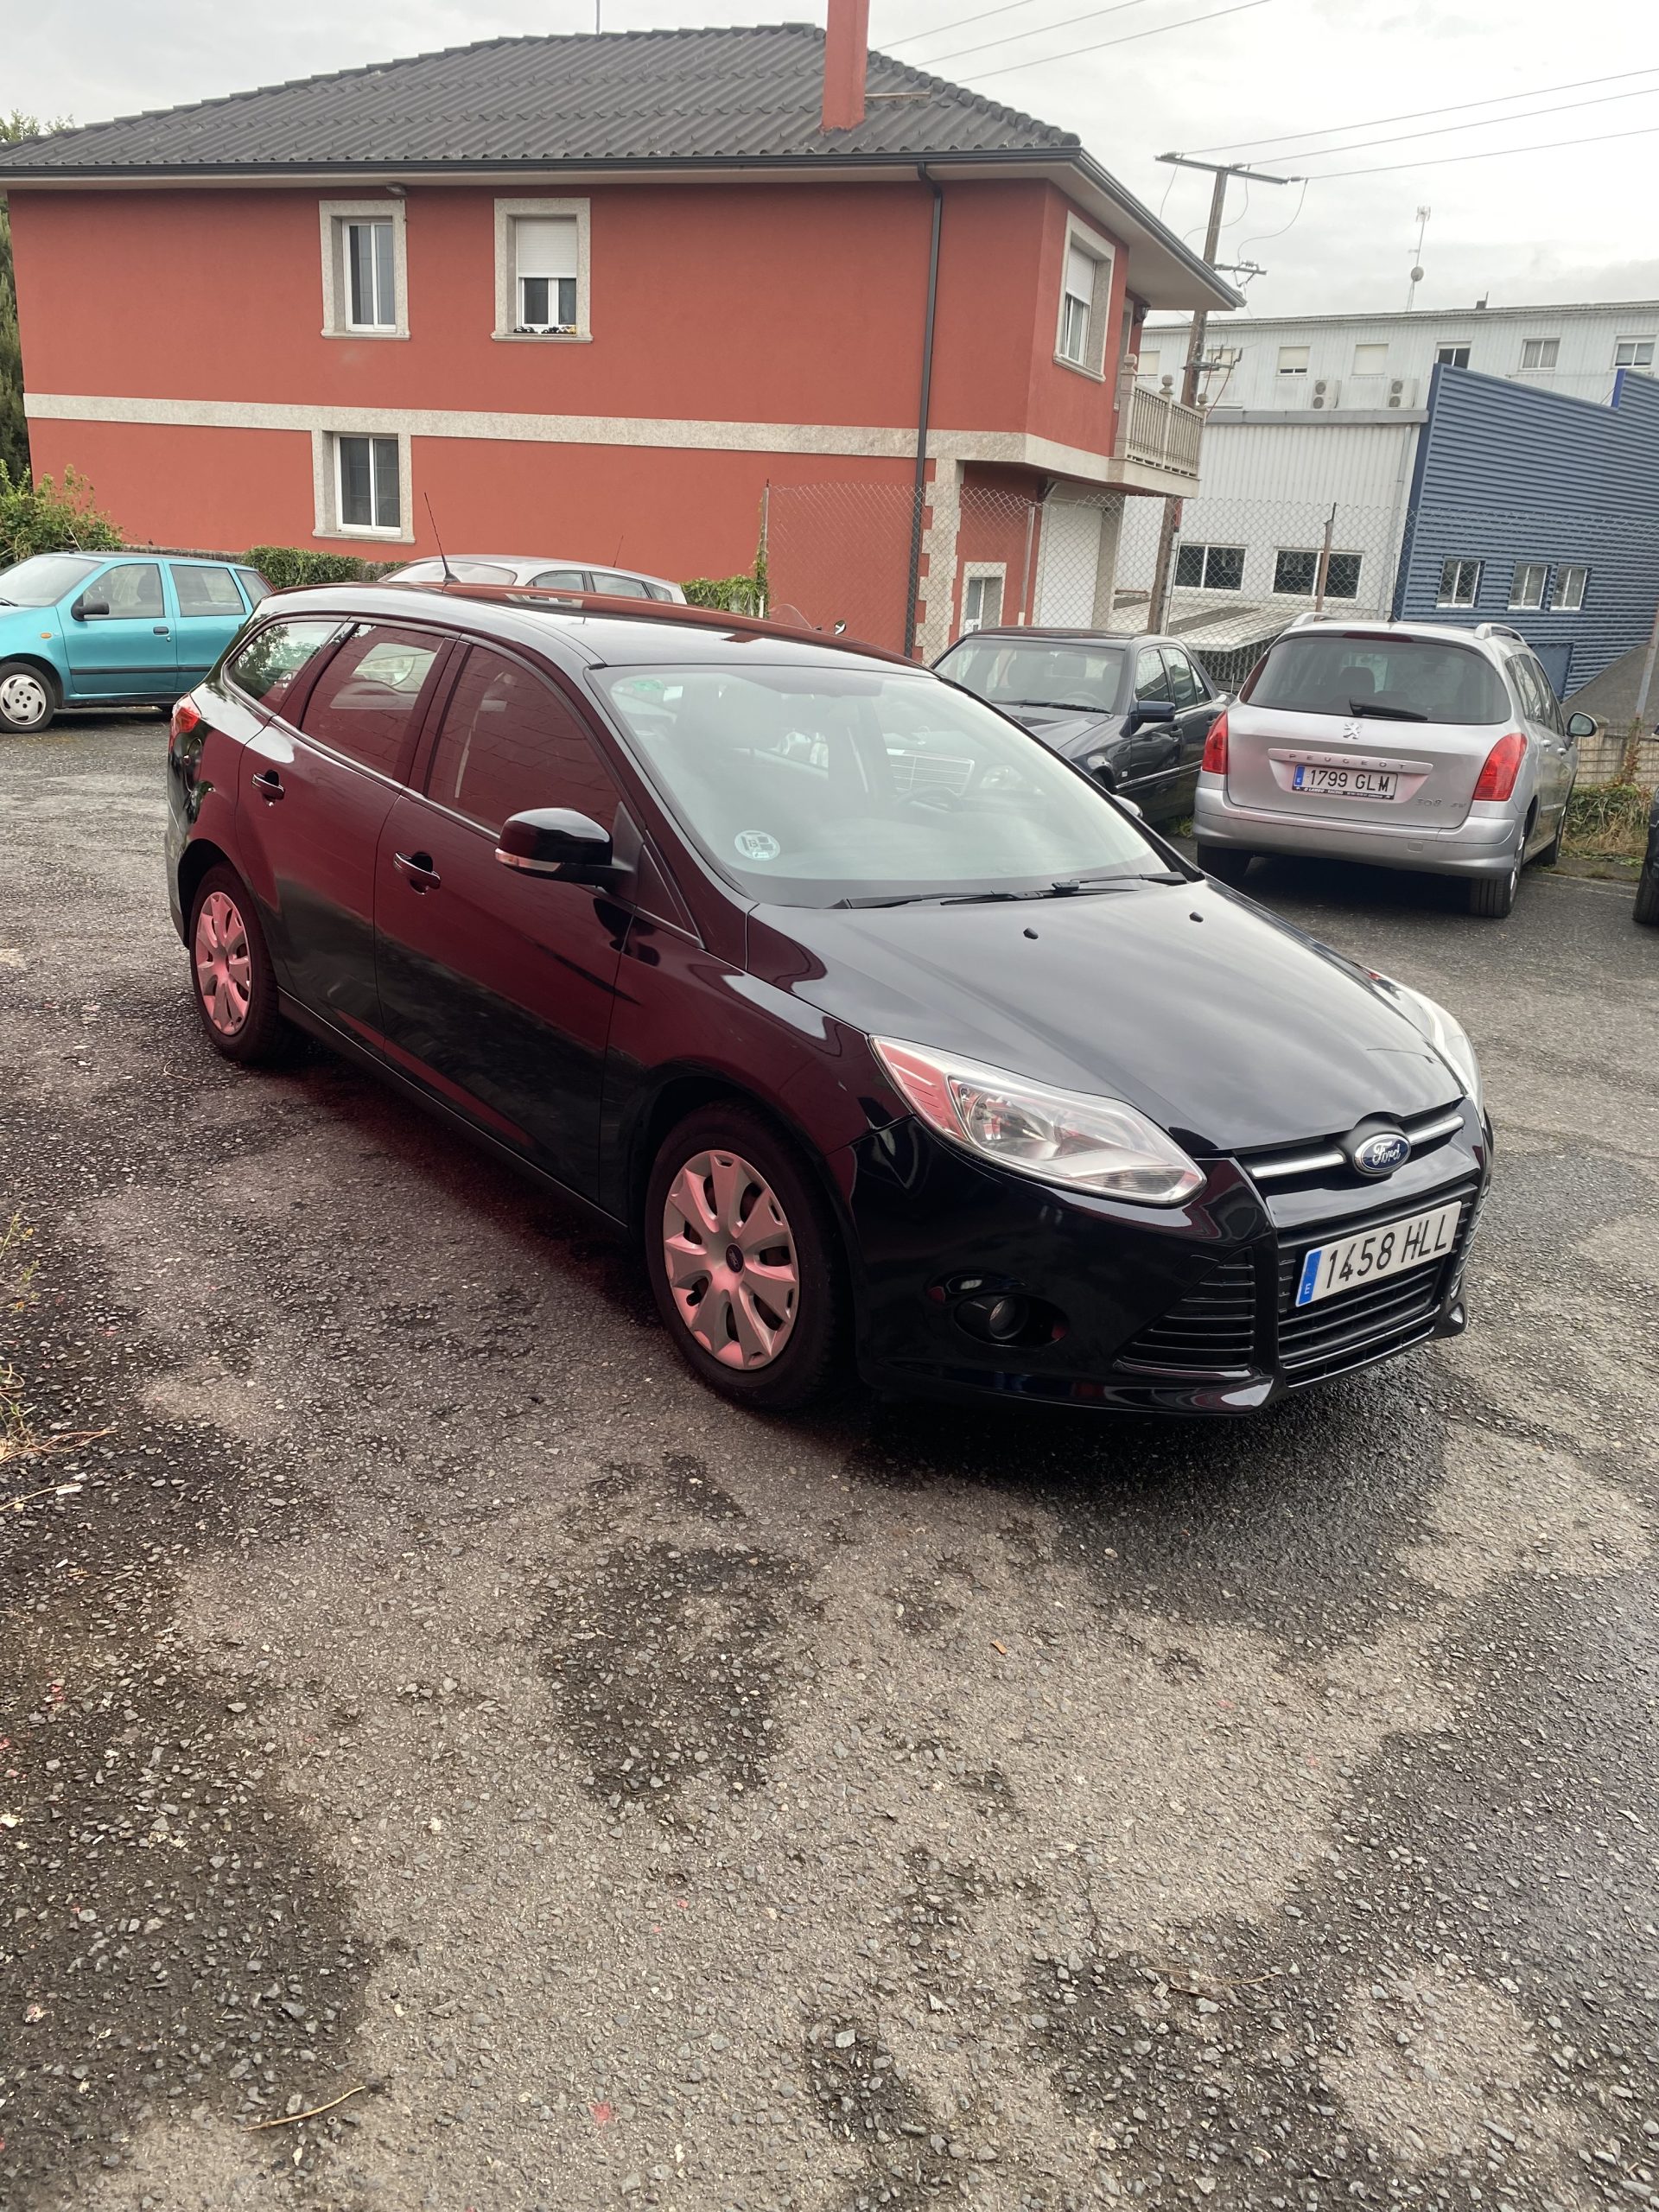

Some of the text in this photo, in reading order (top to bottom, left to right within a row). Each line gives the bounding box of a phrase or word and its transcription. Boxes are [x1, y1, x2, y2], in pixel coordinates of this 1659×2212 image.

[1289, 753, 1406, 769] PEUGEOT
[1311, 770, 1389, 791] 1799 GLM
[1372, 1141, 1402, 1166] Ford
[1326, 1214, 1447, 1288] 1458 HLL
[1304, 1283, 1312, 1294] E
